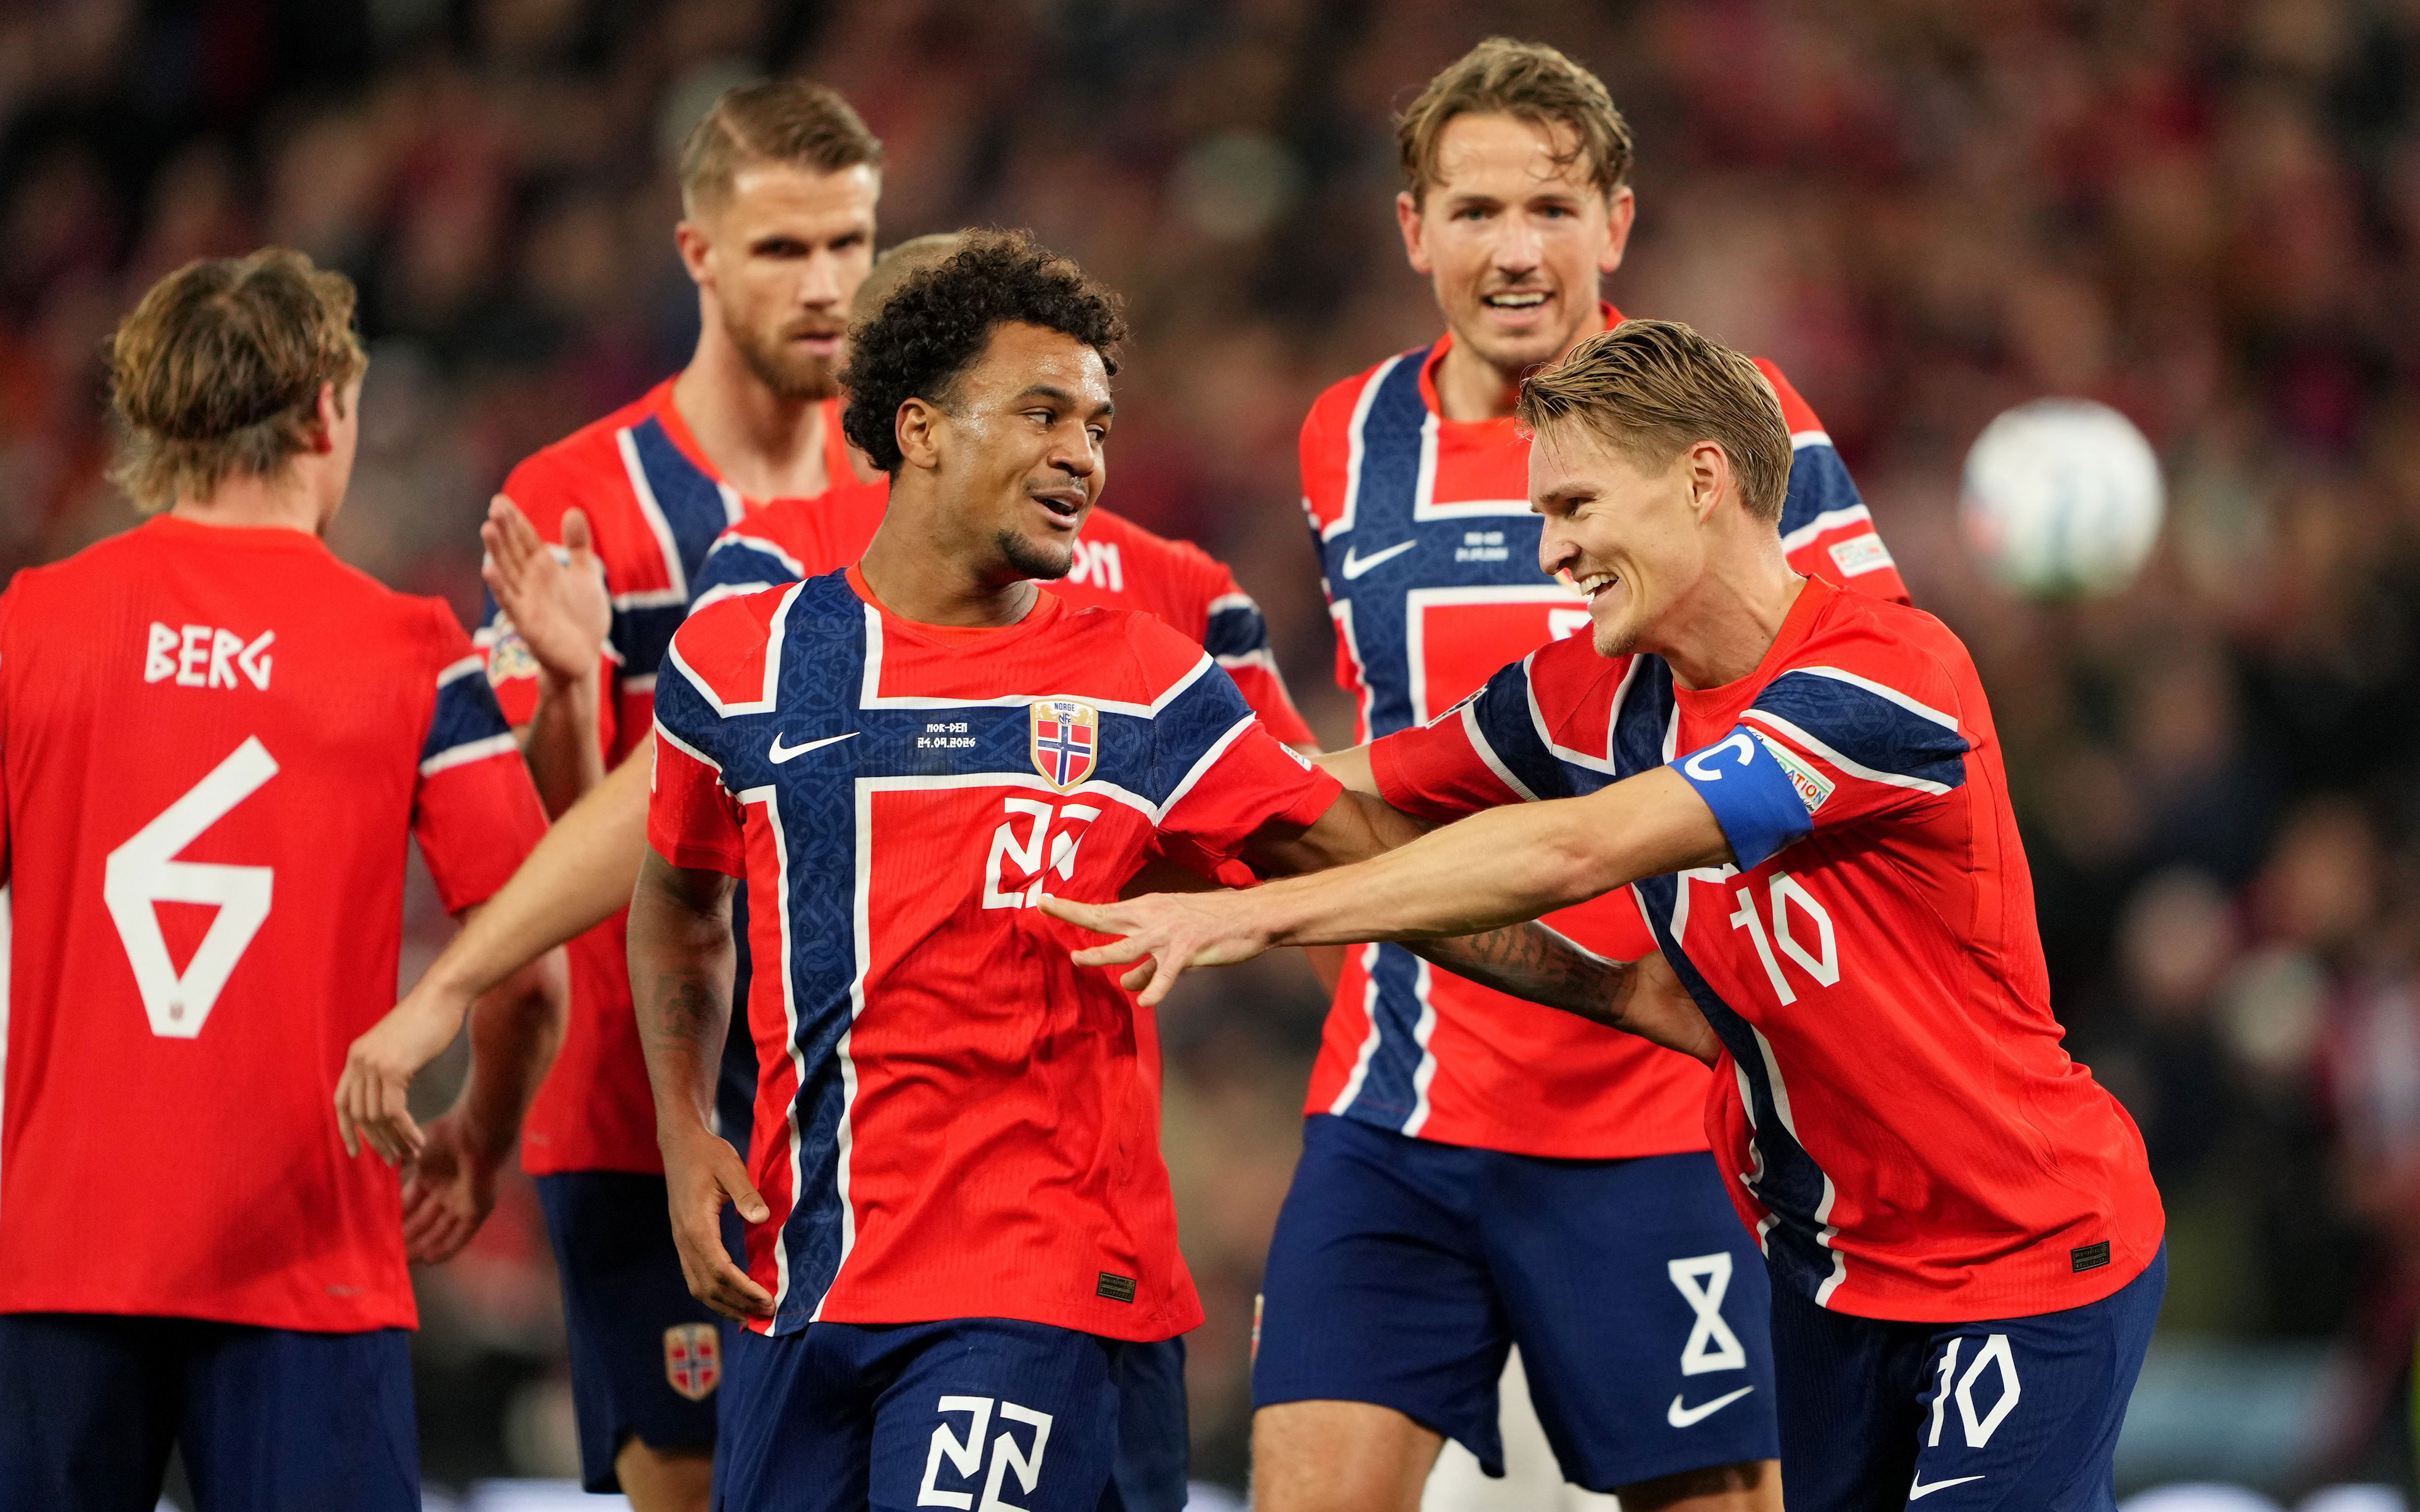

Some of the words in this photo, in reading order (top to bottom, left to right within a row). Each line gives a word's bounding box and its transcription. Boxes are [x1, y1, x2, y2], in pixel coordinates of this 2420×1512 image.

[145, 622, 275, 690] BERG
[917, 737, 976, 748] 24.09.2026
[926, 722, 968, 733] NOR-DEN
[1054, 702, 1075, 712] NORGE
[1684, 733, 1755, 781] C
[104, 735, 279, 1039] 6
[1729, 870, 1840, 1006] 10
[1668, 1252, 1746, 1376] 8
[1928, 1334, 2021, 1448] 10
[917, 1396, 1053, 1512] 22
